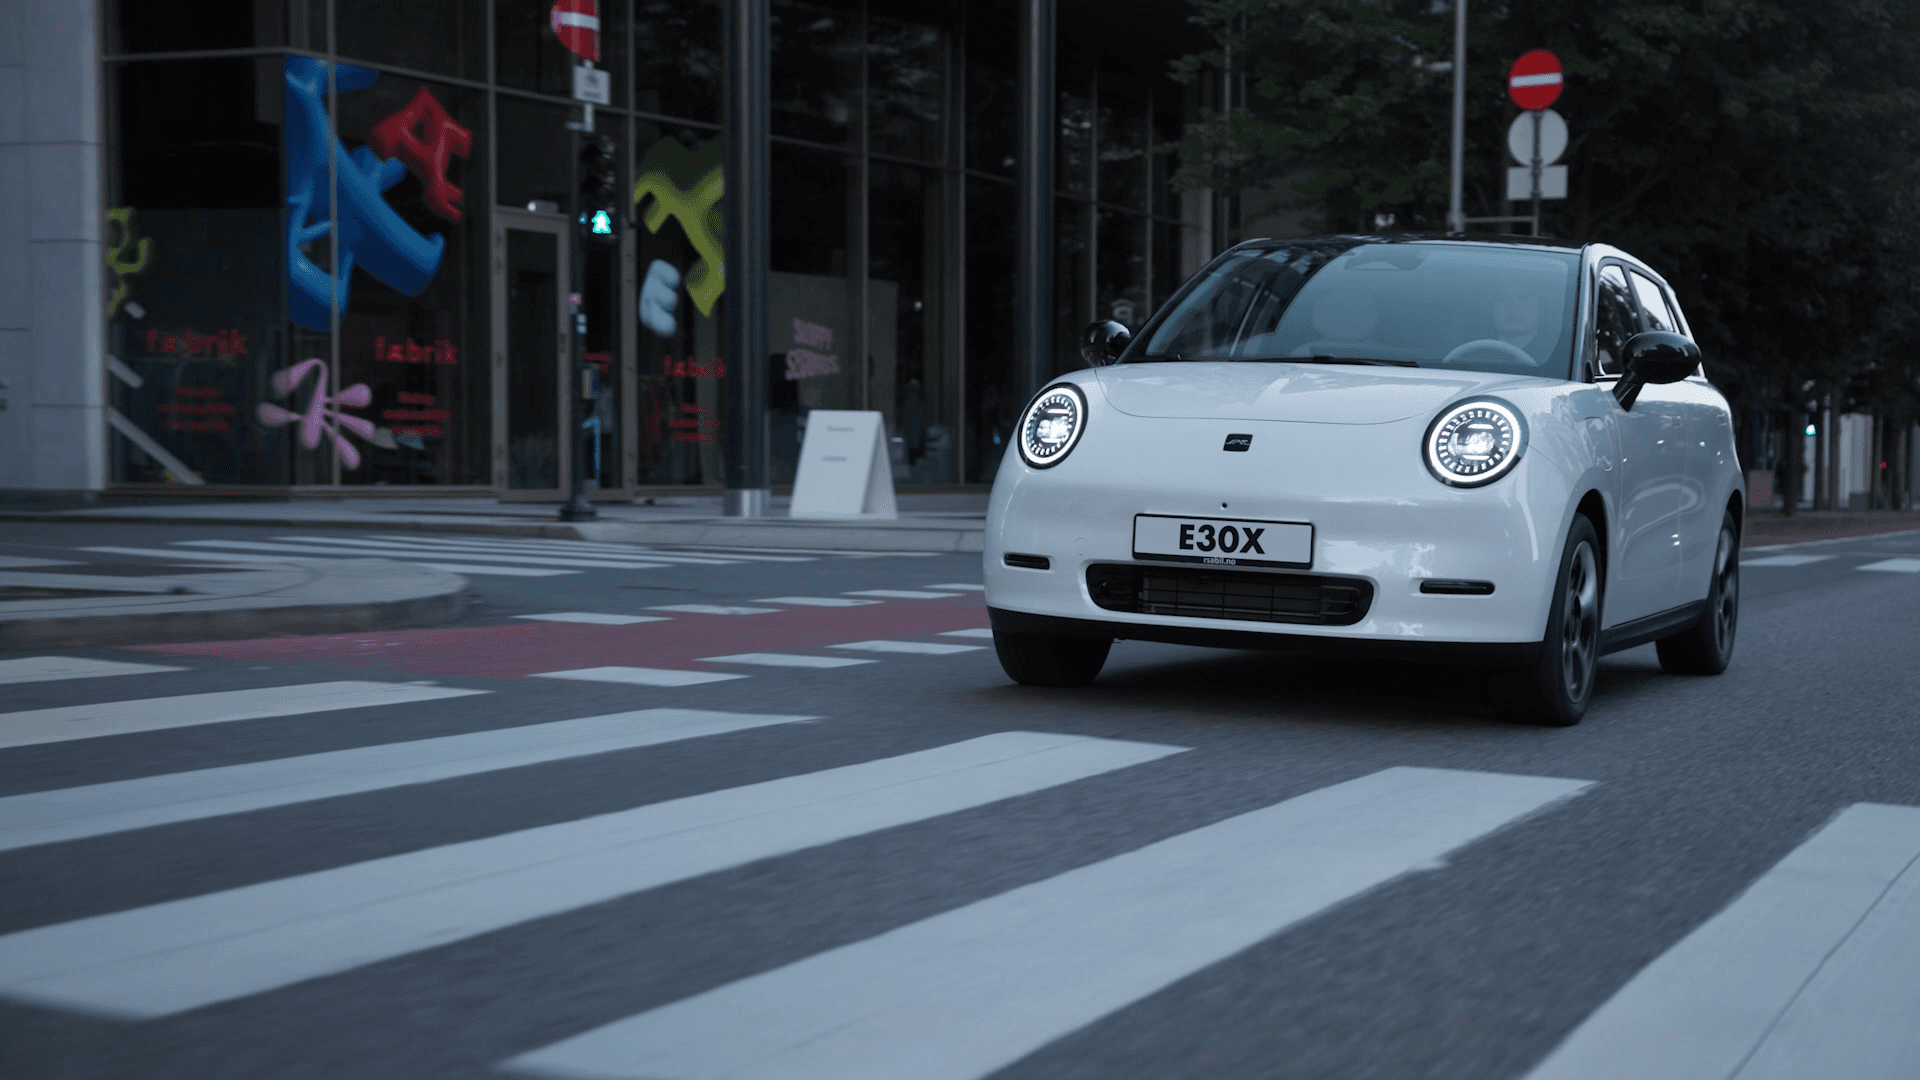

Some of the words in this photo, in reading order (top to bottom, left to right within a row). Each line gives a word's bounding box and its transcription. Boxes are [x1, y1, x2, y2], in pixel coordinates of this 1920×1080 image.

[376, 336, 458, 365] fabrik
[1179, 524, 1265, 554] E30X
[1203, 557, 1236, 566] rsabil.no
